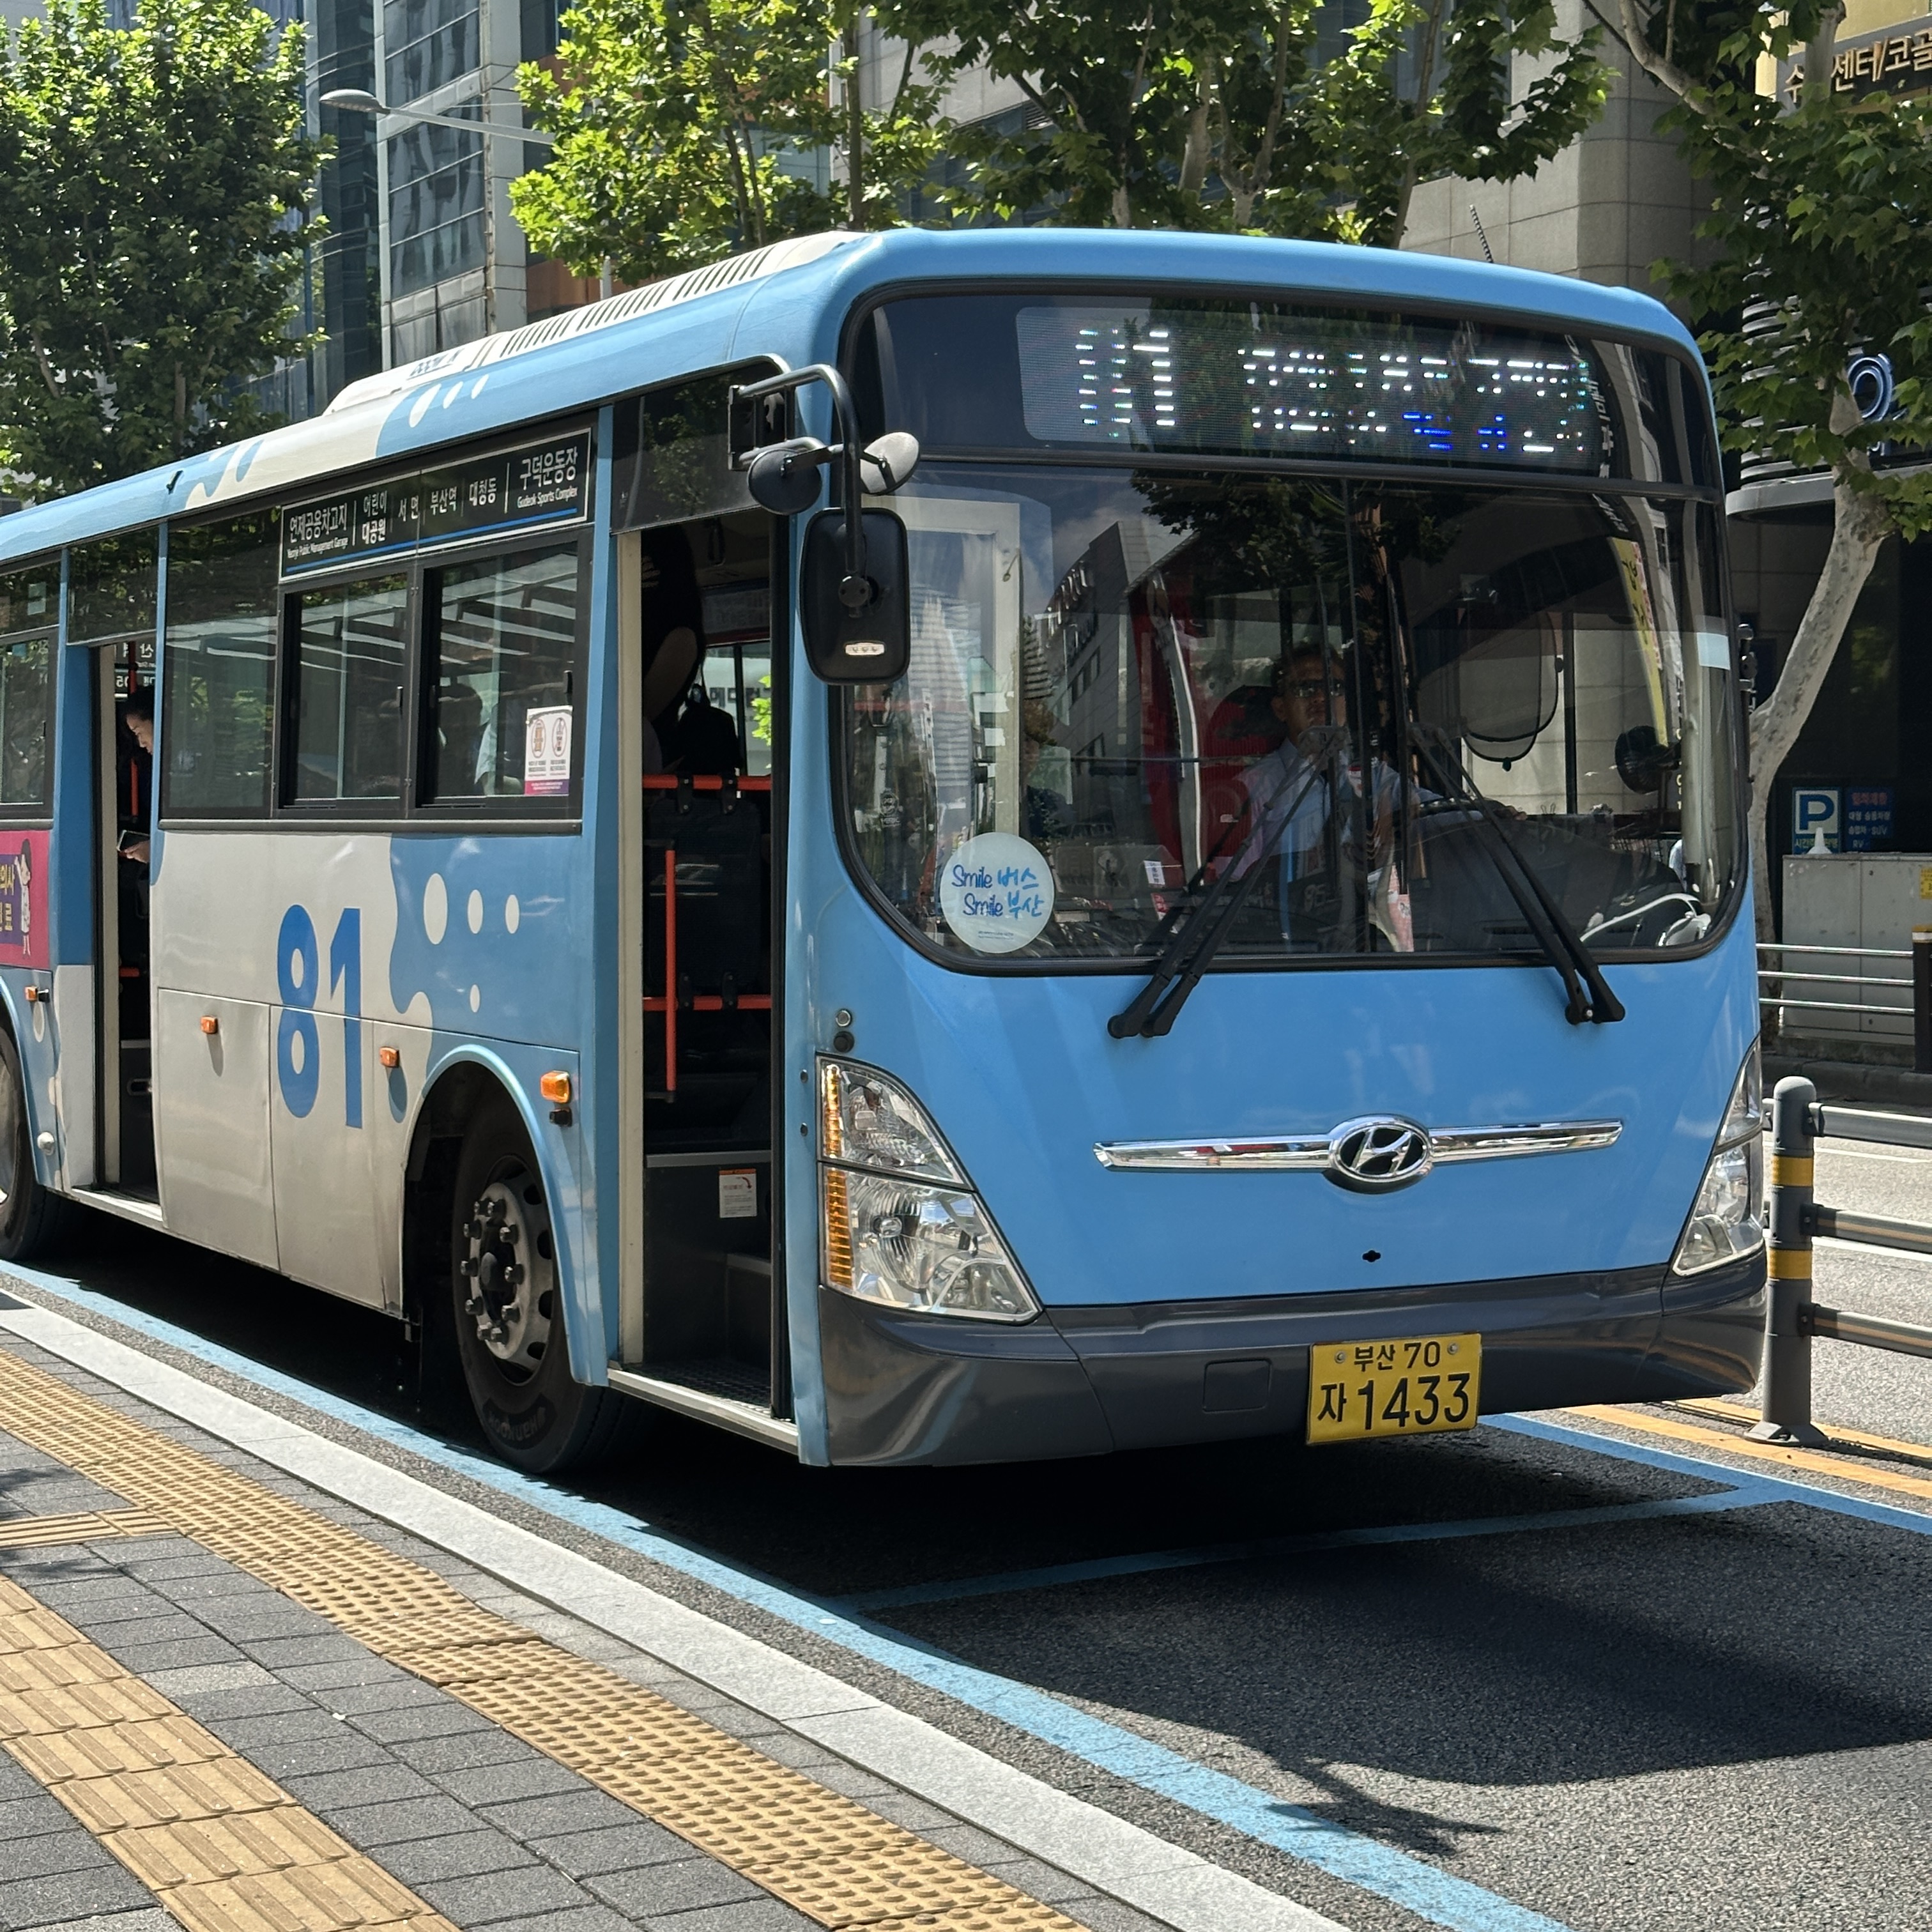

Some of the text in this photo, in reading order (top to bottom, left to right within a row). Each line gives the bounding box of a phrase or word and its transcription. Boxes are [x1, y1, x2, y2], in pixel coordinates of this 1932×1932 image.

[520, 446, 578, 491] 구덕운동장
[363, 490, 388, 518] 어린이
[430, 486, 457, 516] 부산역
[469, 477, 497, 507] 대청동
[289, 502, 348, 544] 연제공용차고지
[362, 518, 387, 545] 대공원
[1799, 794, 1835, 830] P
[951, 864, 1039, 890] Smile 버스
[963, 889, 1045, 920] Smile 부산
[277, 903, 363, 1130] 81
